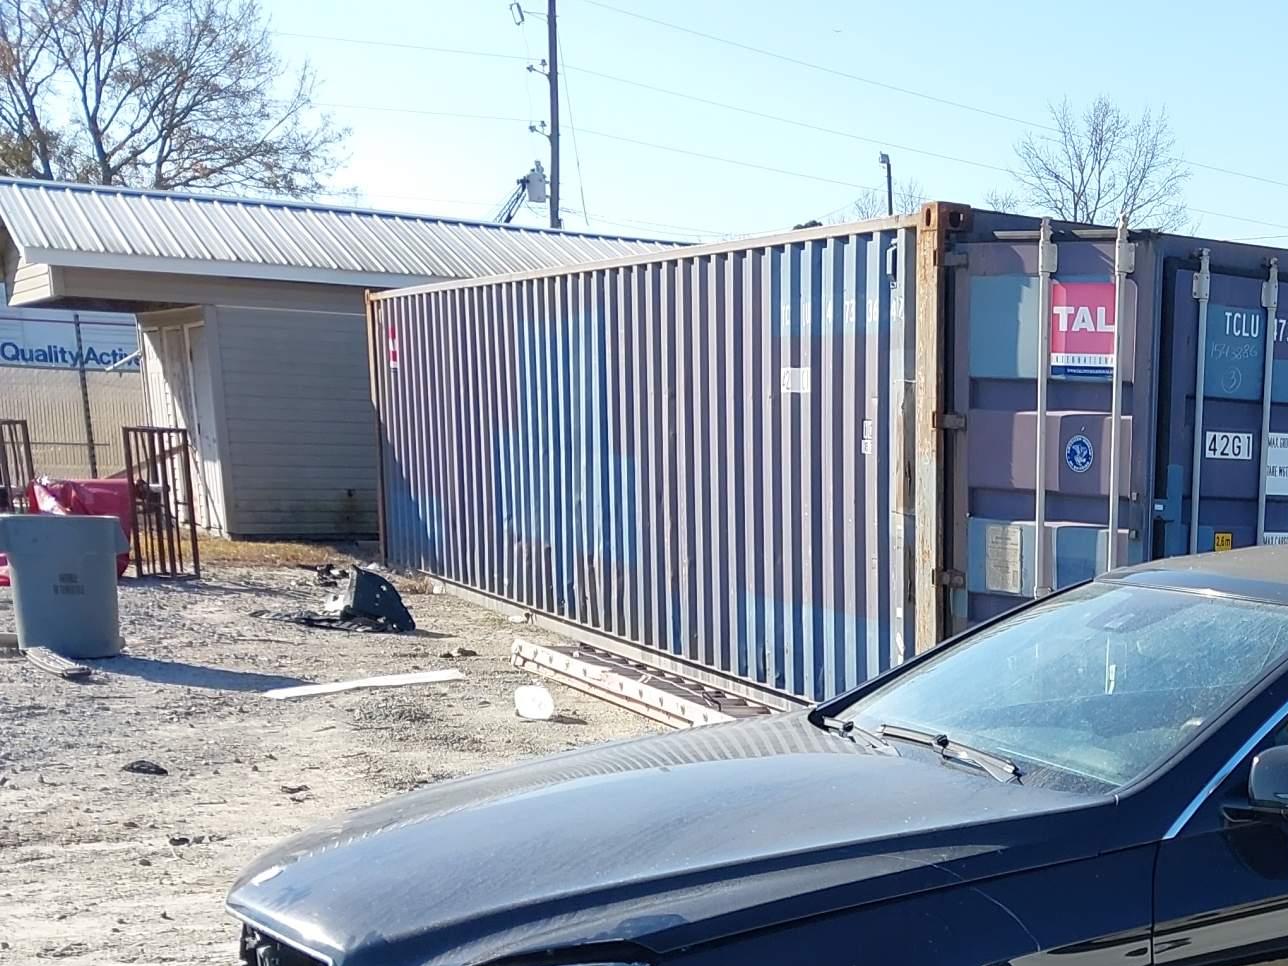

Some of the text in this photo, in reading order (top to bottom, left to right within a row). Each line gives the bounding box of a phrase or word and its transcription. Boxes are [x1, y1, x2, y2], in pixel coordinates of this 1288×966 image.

[1053, 306, 1115, 332] TAL
[1225, 312, 1259, 337] TCLU
[0, 342, 80, 367] Quality
[1208, 434, 1251, 457] 42G1
